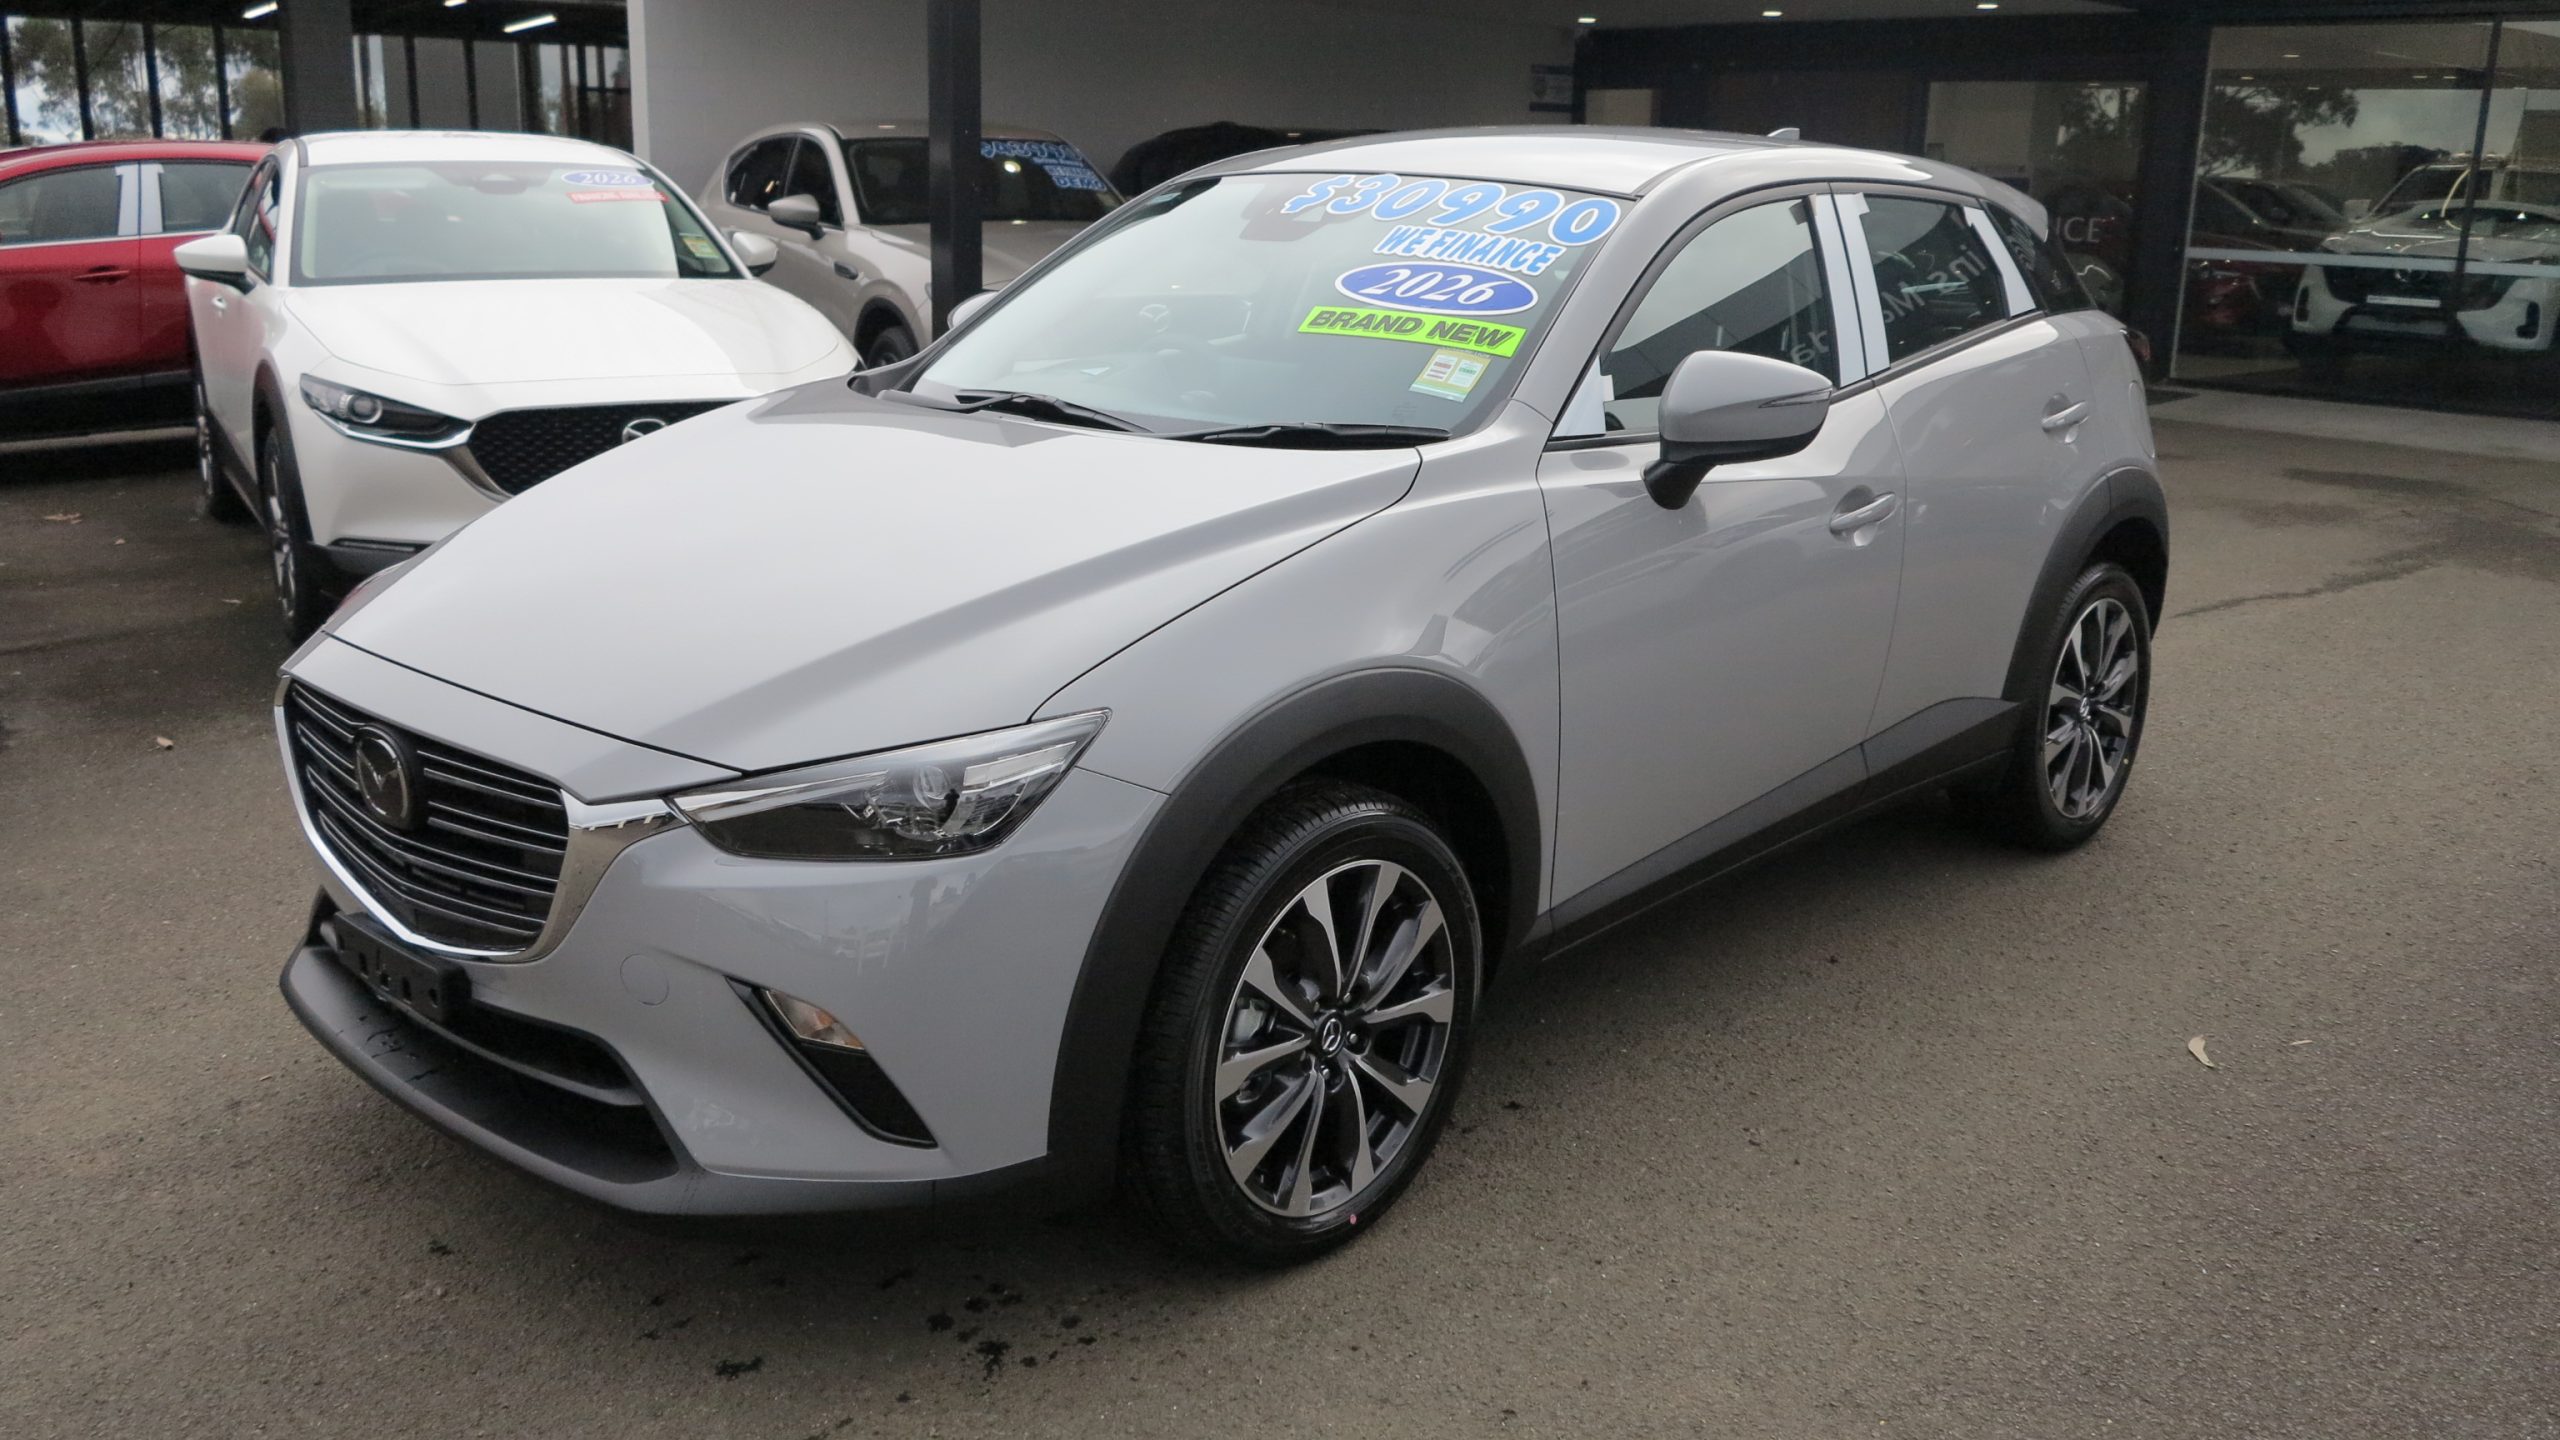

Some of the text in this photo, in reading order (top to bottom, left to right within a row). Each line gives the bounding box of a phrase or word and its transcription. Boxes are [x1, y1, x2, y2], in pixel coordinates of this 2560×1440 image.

[581, 172, 637, 185] 2026
[1281, 173, 1621, 246] $30990
[1373, 225, 1567, 277] WE FINANCE
[1359, 268, 1512, 305] 2026
[1308, 310, 1516, 350] BRAND NEW
